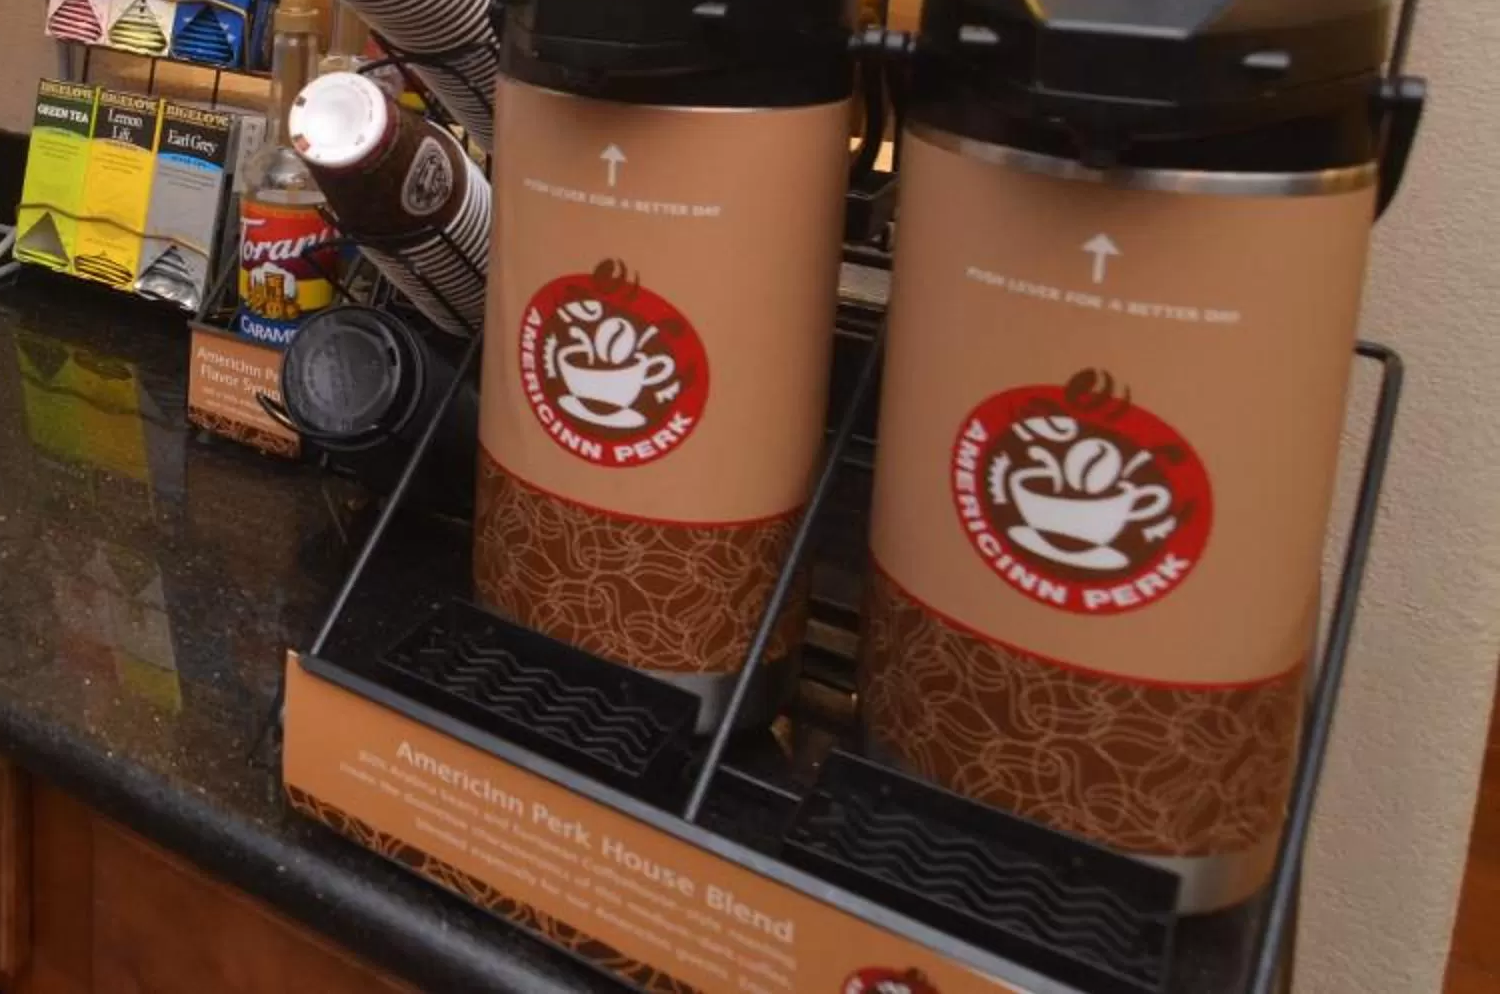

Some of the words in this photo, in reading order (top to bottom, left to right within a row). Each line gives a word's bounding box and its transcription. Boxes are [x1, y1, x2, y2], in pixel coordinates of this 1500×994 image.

[37, 102, 69, 119] GREEN
[70, 109, 89, 123] TEA
[107, 108, 143, 127] Lemon
[167, 128, 191, 147] Earl
[191, 134, 219, 157] Grey
[241, 315, 299, 344] CARAM
[201, 363, 239, 387] Flavor
[265, 367, 280, 383] Pe
[521, 307, 604, 462] AMERICINN
[613, 410, 695, 463] PERK
[955, 419, 1068, 607] AMERICINN
[1082, 552, 1193, 610] PERK
[395, 740, 525, 816] AmericInn
[531, 801, 593, 850] Perk
[602, 836, 696, 898] House
[706, 883, 796, 944] Blend
